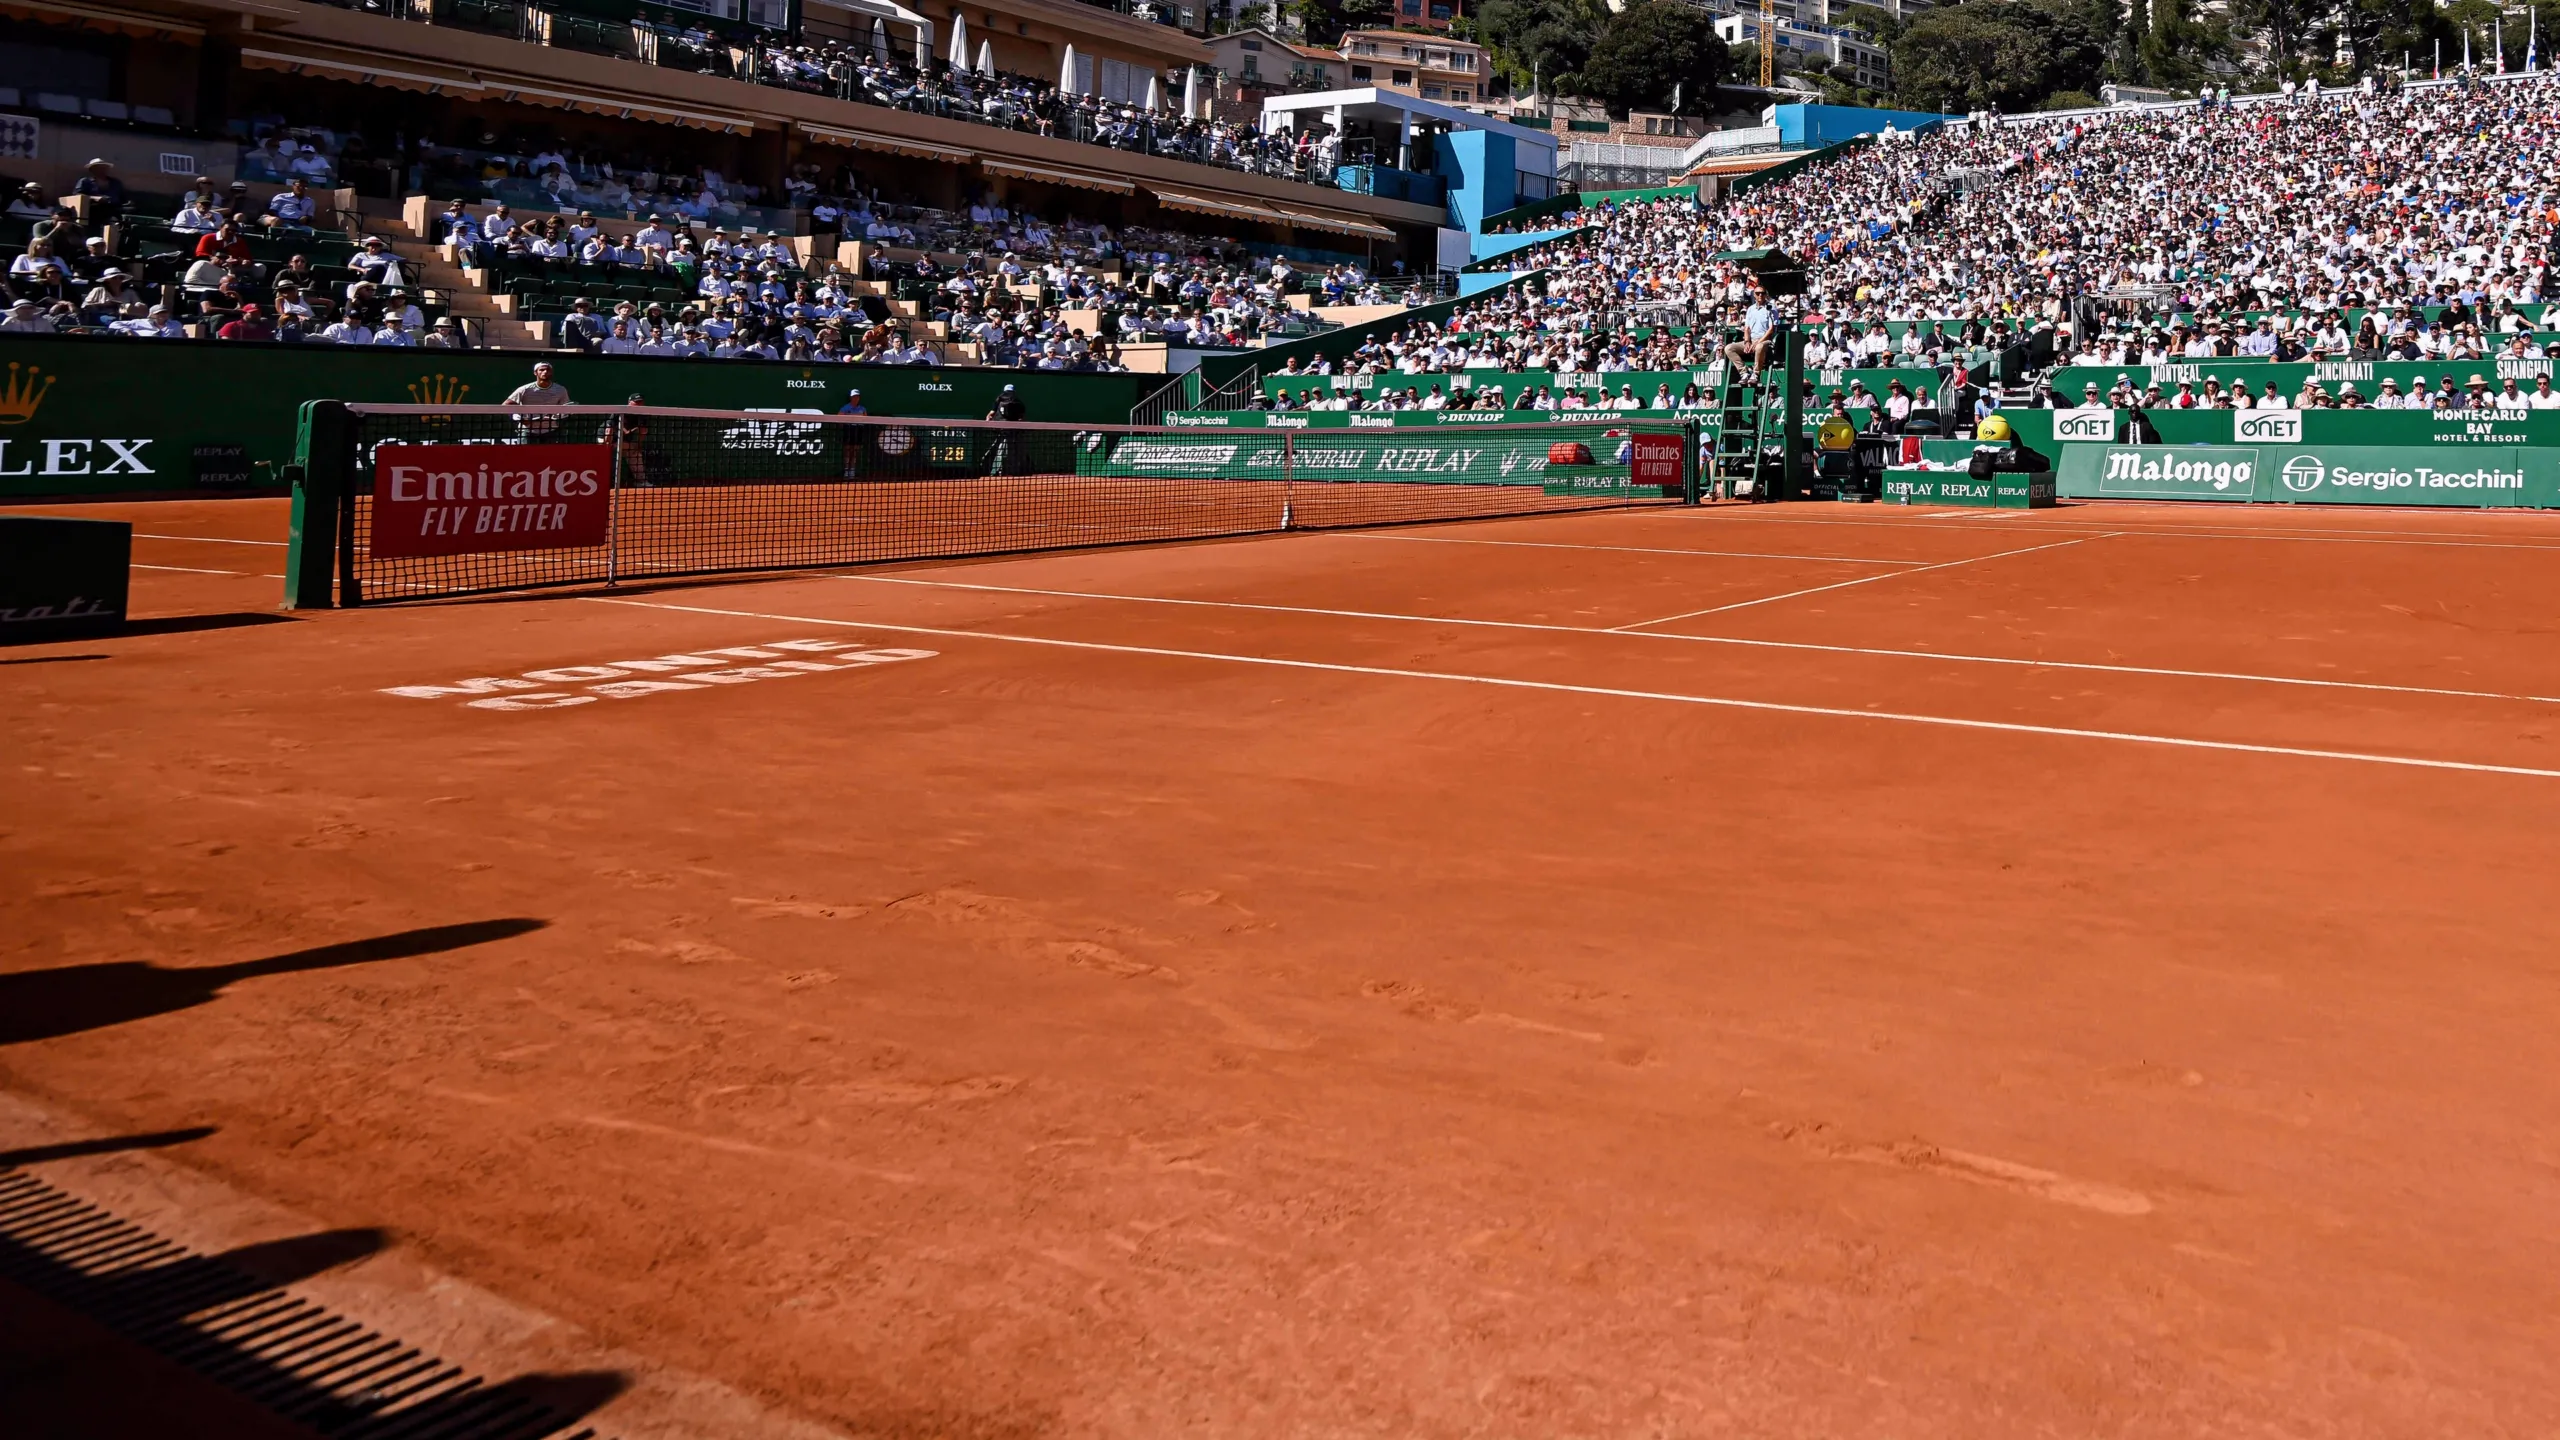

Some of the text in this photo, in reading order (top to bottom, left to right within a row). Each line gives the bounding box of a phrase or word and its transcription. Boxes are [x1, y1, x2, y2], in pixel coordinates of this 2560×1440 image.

[1820, 369, 1843, 386] ROME
[2151, 364, 2201, 383] MONTREAL
[2314, 362, 2373, 381] CINCINNATI
[2496, 360, 2554, 380] SHANGHAI
[787, 380, 826, 389] ROLEX
[1352, 375, 1373, 389] WELLS
[1450, 375, 1472, 390] MIAMI
[1554, 373, 1603, 389] MONTE-CARLO
[1693, 371, 1722, 387] MADRID
[918, 383, 953, 391] ROLEX
[1179, 416, 1229, 426] Sergio Tacchini
[1267, 414, 1307, 429] Malongo
[1350, 414, 1393, 428] Malongo
[1448, 413, 1504, 422] DUNLOP
[1561, 413, 1622, 422] DUNLOP
[2433, 410, 2528, 421] MONTE-CARLO
[2466, 422, 2494, 434] BAY
[2434, 434, 2528, 443] HOTEL & RESORT
[193, 447, 243, 456] REPLAY
[720, 439, 824, 455] MASTERS 1000
[930, 446, 964, 461] 1:28
[1635, 443, 1680, 460] Emirates
[1375, 449, 1484, 471] REPLAY
[1860, 446, 1900, 467] VALMO
[1640, 462, 1673, 476] FLY BETTER
[2105, 453, 2252, 491] Malongo
[201, 473, 250, 482] REPLAY
[390, 463, 598, 502] Emirates
[2330, 467, 2524, 490] Sergio Tacchini
[1887, 483, 1934, 496] REPLAY
[1941, 484, 1991, 497] REPLAY
[1997, 487, 2028, 496] REPLAY
[2030, 483, 2056, 499] REPLAY
[420, 503, 568, 536] FLY BETTER
[373, 638, 869, 698] MONTE
[461, 648, 941, 711] CARLO
